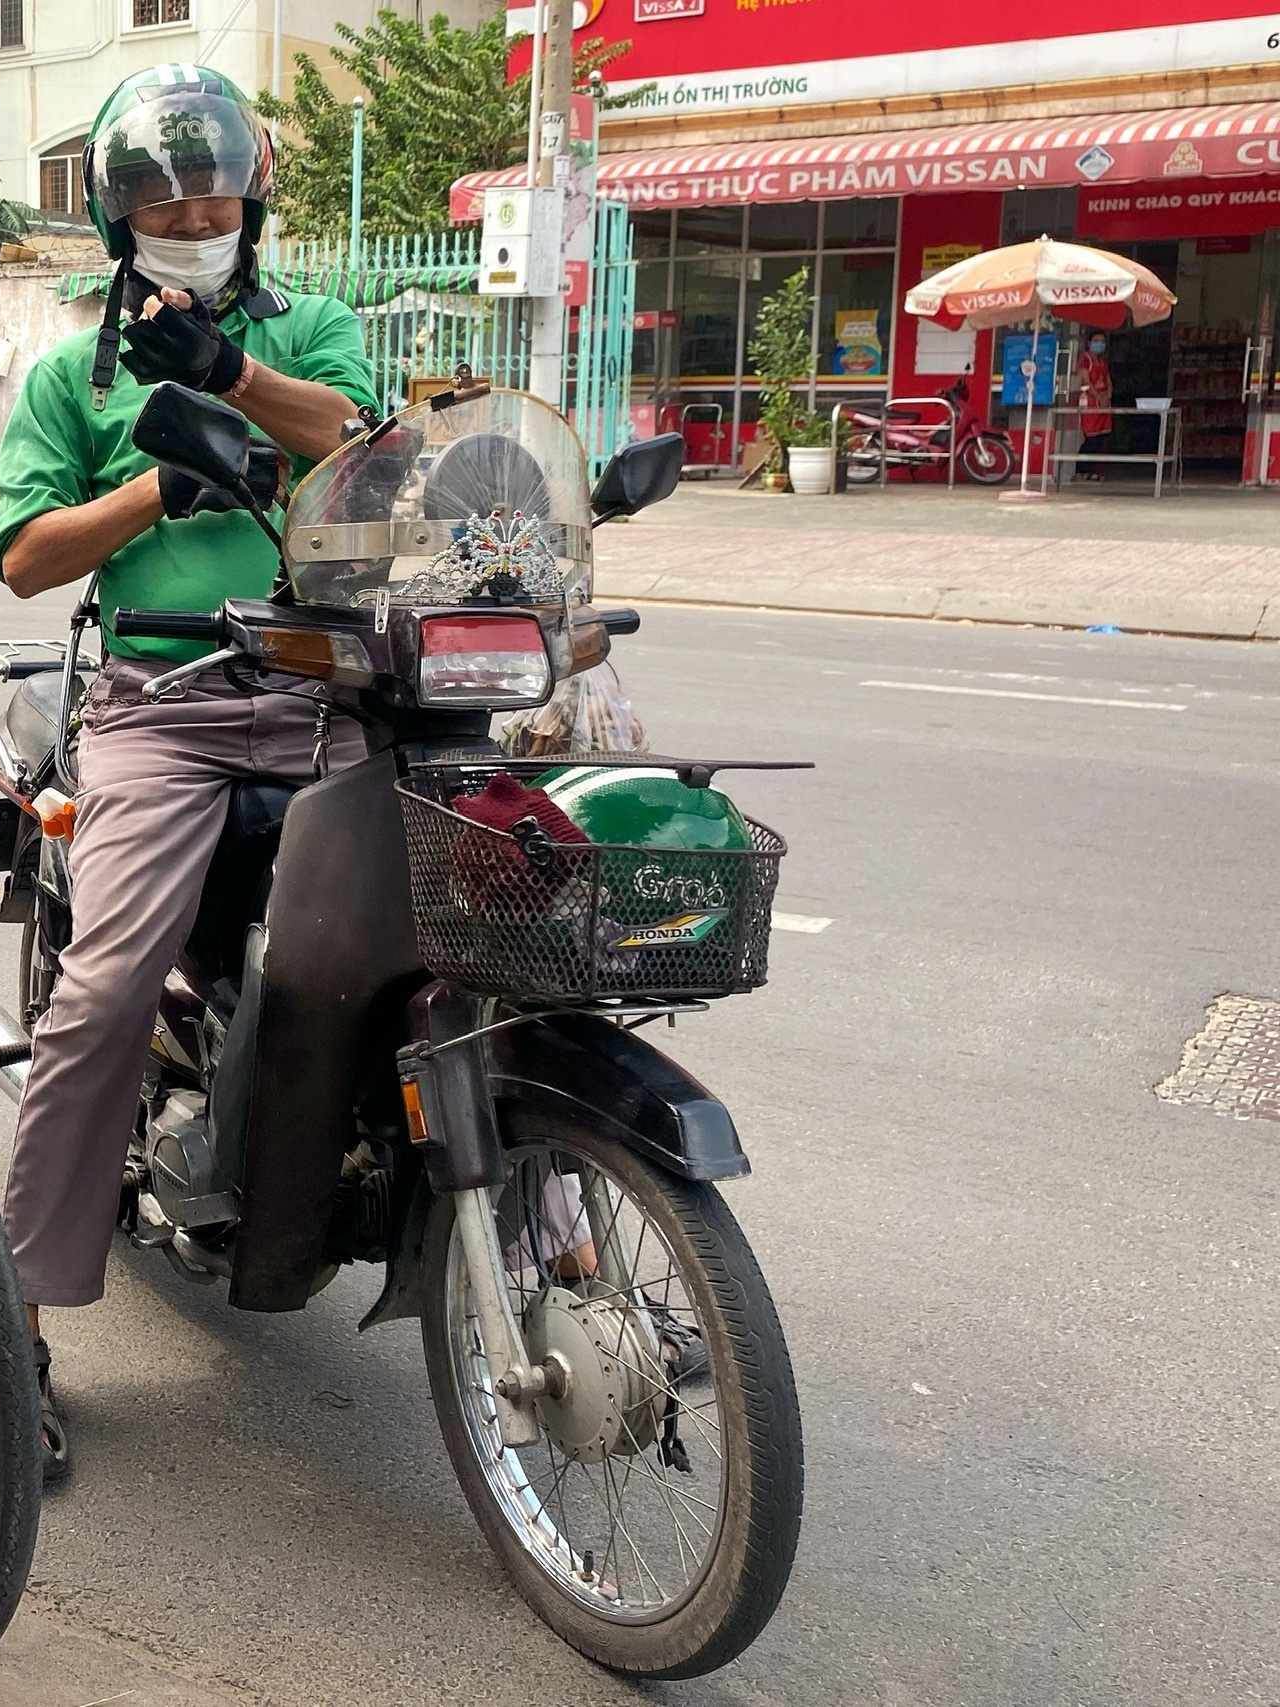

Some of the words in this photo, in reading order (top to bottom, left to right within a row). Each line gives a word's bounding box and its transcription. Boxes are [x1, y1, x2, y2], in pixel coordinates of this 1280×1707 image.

[703, 85, 730, 103] THỊ
[733, 77, 808, 99] TRƯỜNG
[157, 112, 222, 143] Grab
[685, 171, 781, 202] THỰC
[905, 155, 1047, 187] VISSAN
[1229, 188, 1280, 206] KHÁC
[961, 290, 1020, 311] VISSAN
[1052, 285, 1117, 301] VISSAN
[631, 927, 696, 940] HONDA
